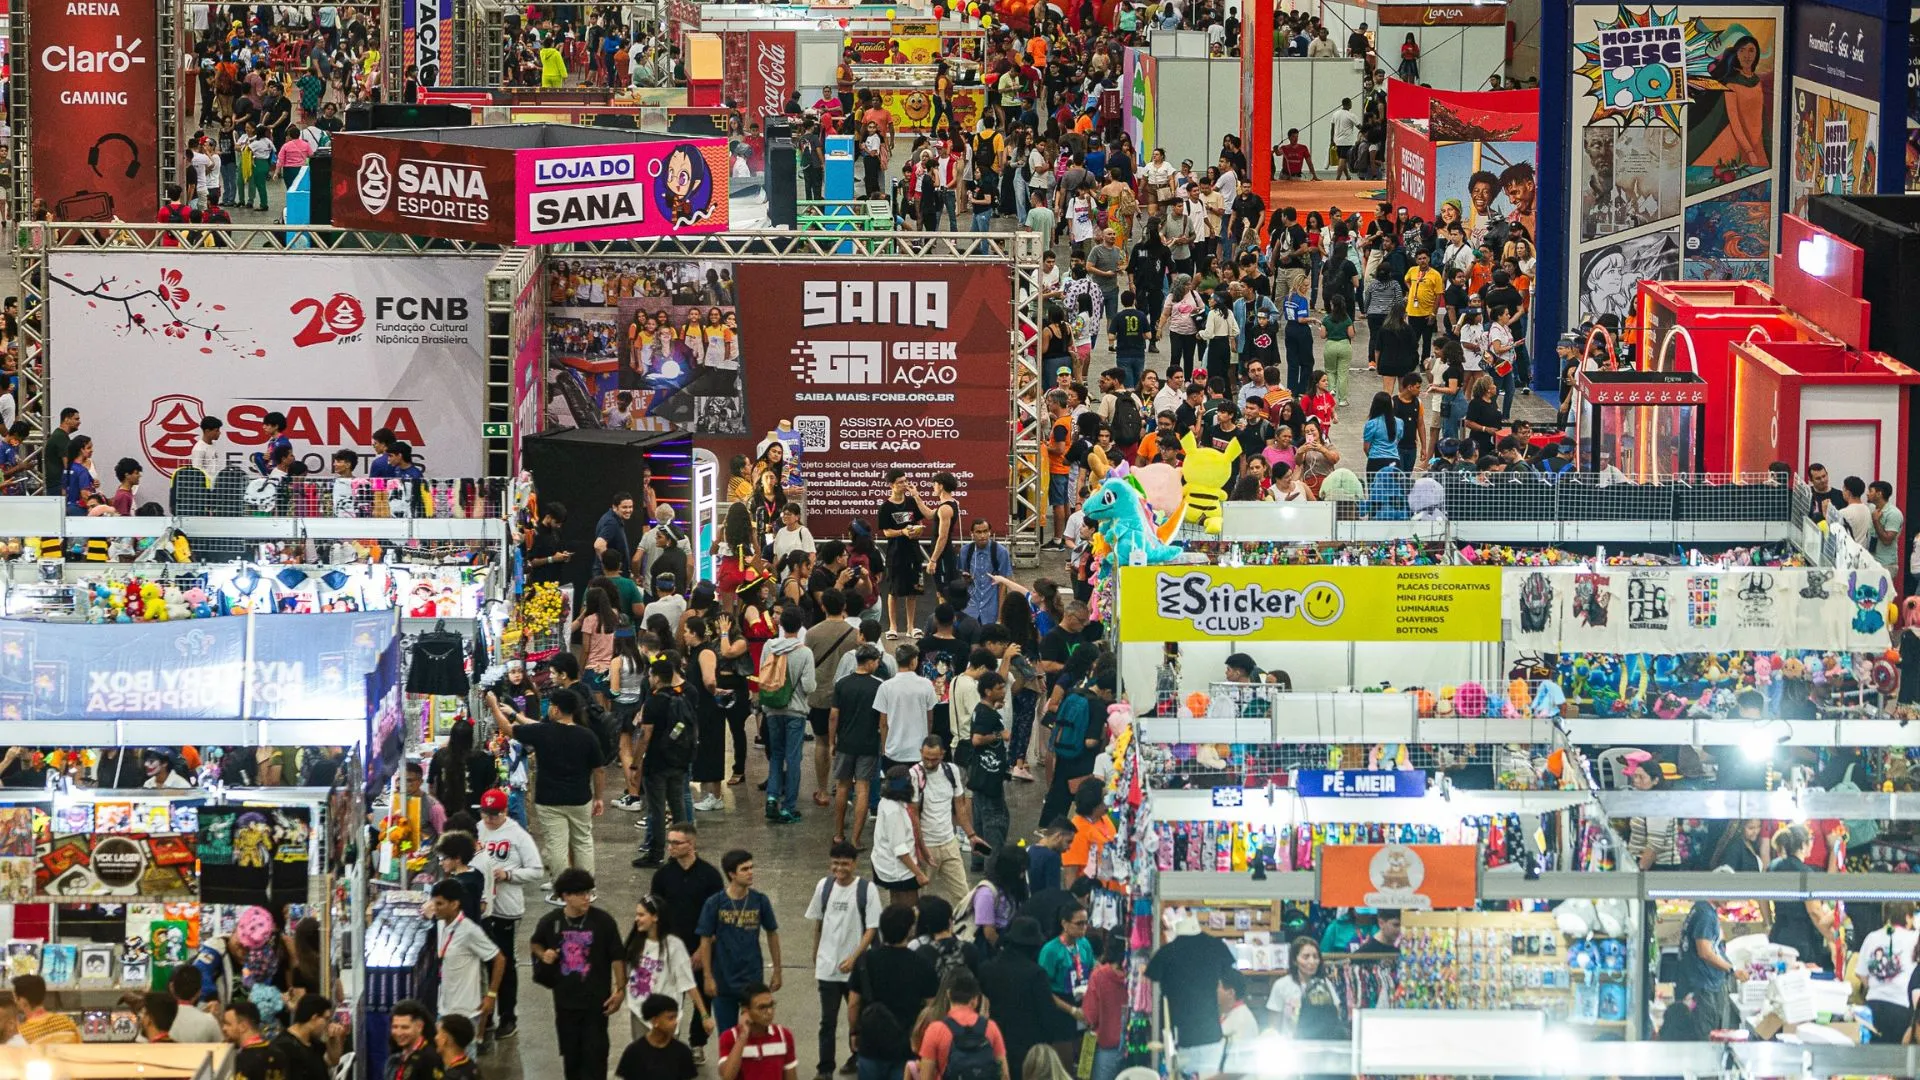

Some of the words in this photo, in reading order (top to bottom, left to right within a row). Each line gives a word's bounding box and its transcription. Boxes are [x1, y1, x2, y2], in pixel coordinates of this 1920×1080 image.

[66, 2, 120, 16] ARENA
[417, 0, 440, 87] AÇÃO
[1602, 27, 1682, 46] MOSTRA
[42, 38, 138, 73] Claro
[1602, 42, 1682, 68] SESC
[60, 91, 128, 105] GAMING
[1825, 124, 1847, 143] MOSTRA
[538, 161, 596, 180] LOJA
[600, 159, 630, 176] DO
[1825, 145, 1847, 176] SESC
[398, 163, 489, 200] SANA
[398, 196, 489, 220] ESPORTES
[536, 192, 636, 225] SANA
[375, 297, 469, 321] FCNB
[804, 281, 949, 329] SANA
[290, 292, 366, 348] 20
[375, 322, 426, 334] Fundação
[429, 322, 468, 332] Cultural
[1125, 316, 1138, 332] 10
[375, 334, 420, 345] Nipônica
[421, 334, 468, 345] Brasileira
[892, 341, 957, 360] GEEK
[892, 362, 957, 388] AÇÃO
[795, 393, 835, 402] SAIBA
[835, 393, 870, 402] MAIS:
[872, 393, 955, 402] FCNB.ORG.BR
[226, 405, 426, 447] SANA
[840, 417, 892, 428] ASSISTA
[894, 417, 912, 428] AO
[915, 415, 954, 428] VÍDEO
[839, 429, 883, 439] SOBRE
[886, 429, 897, 439] O
[900, 429, 960, 439] PROJETO
[839, 441, 878, 450] GEEK
[880, 439, 921, 453] AÇÃO
[817, 470, 841, 479] geek
[852, 462, 869, 470] que
[890, 460, 956, 469] democratizar
[824, 507, 861, 515] inclusão
[1397, 572, 1440, 580] ADESIVOS
[1161, 577, 1181, 615] MY
[1183, 576, 1296, 615] Sticker
[1397, 583, 1430, 591] PLACAS
[1431, 583, 1491, 591] DECORATIVAS
[1396, 594, 1417, 602] MINI
[1418, 594, 1454, 602] FIGURES
[1205, 616, 1250, 630] CLUB
[1322, 771, 1345, 792] PÉ
[1355, 775, 1396, 792] MEIA
